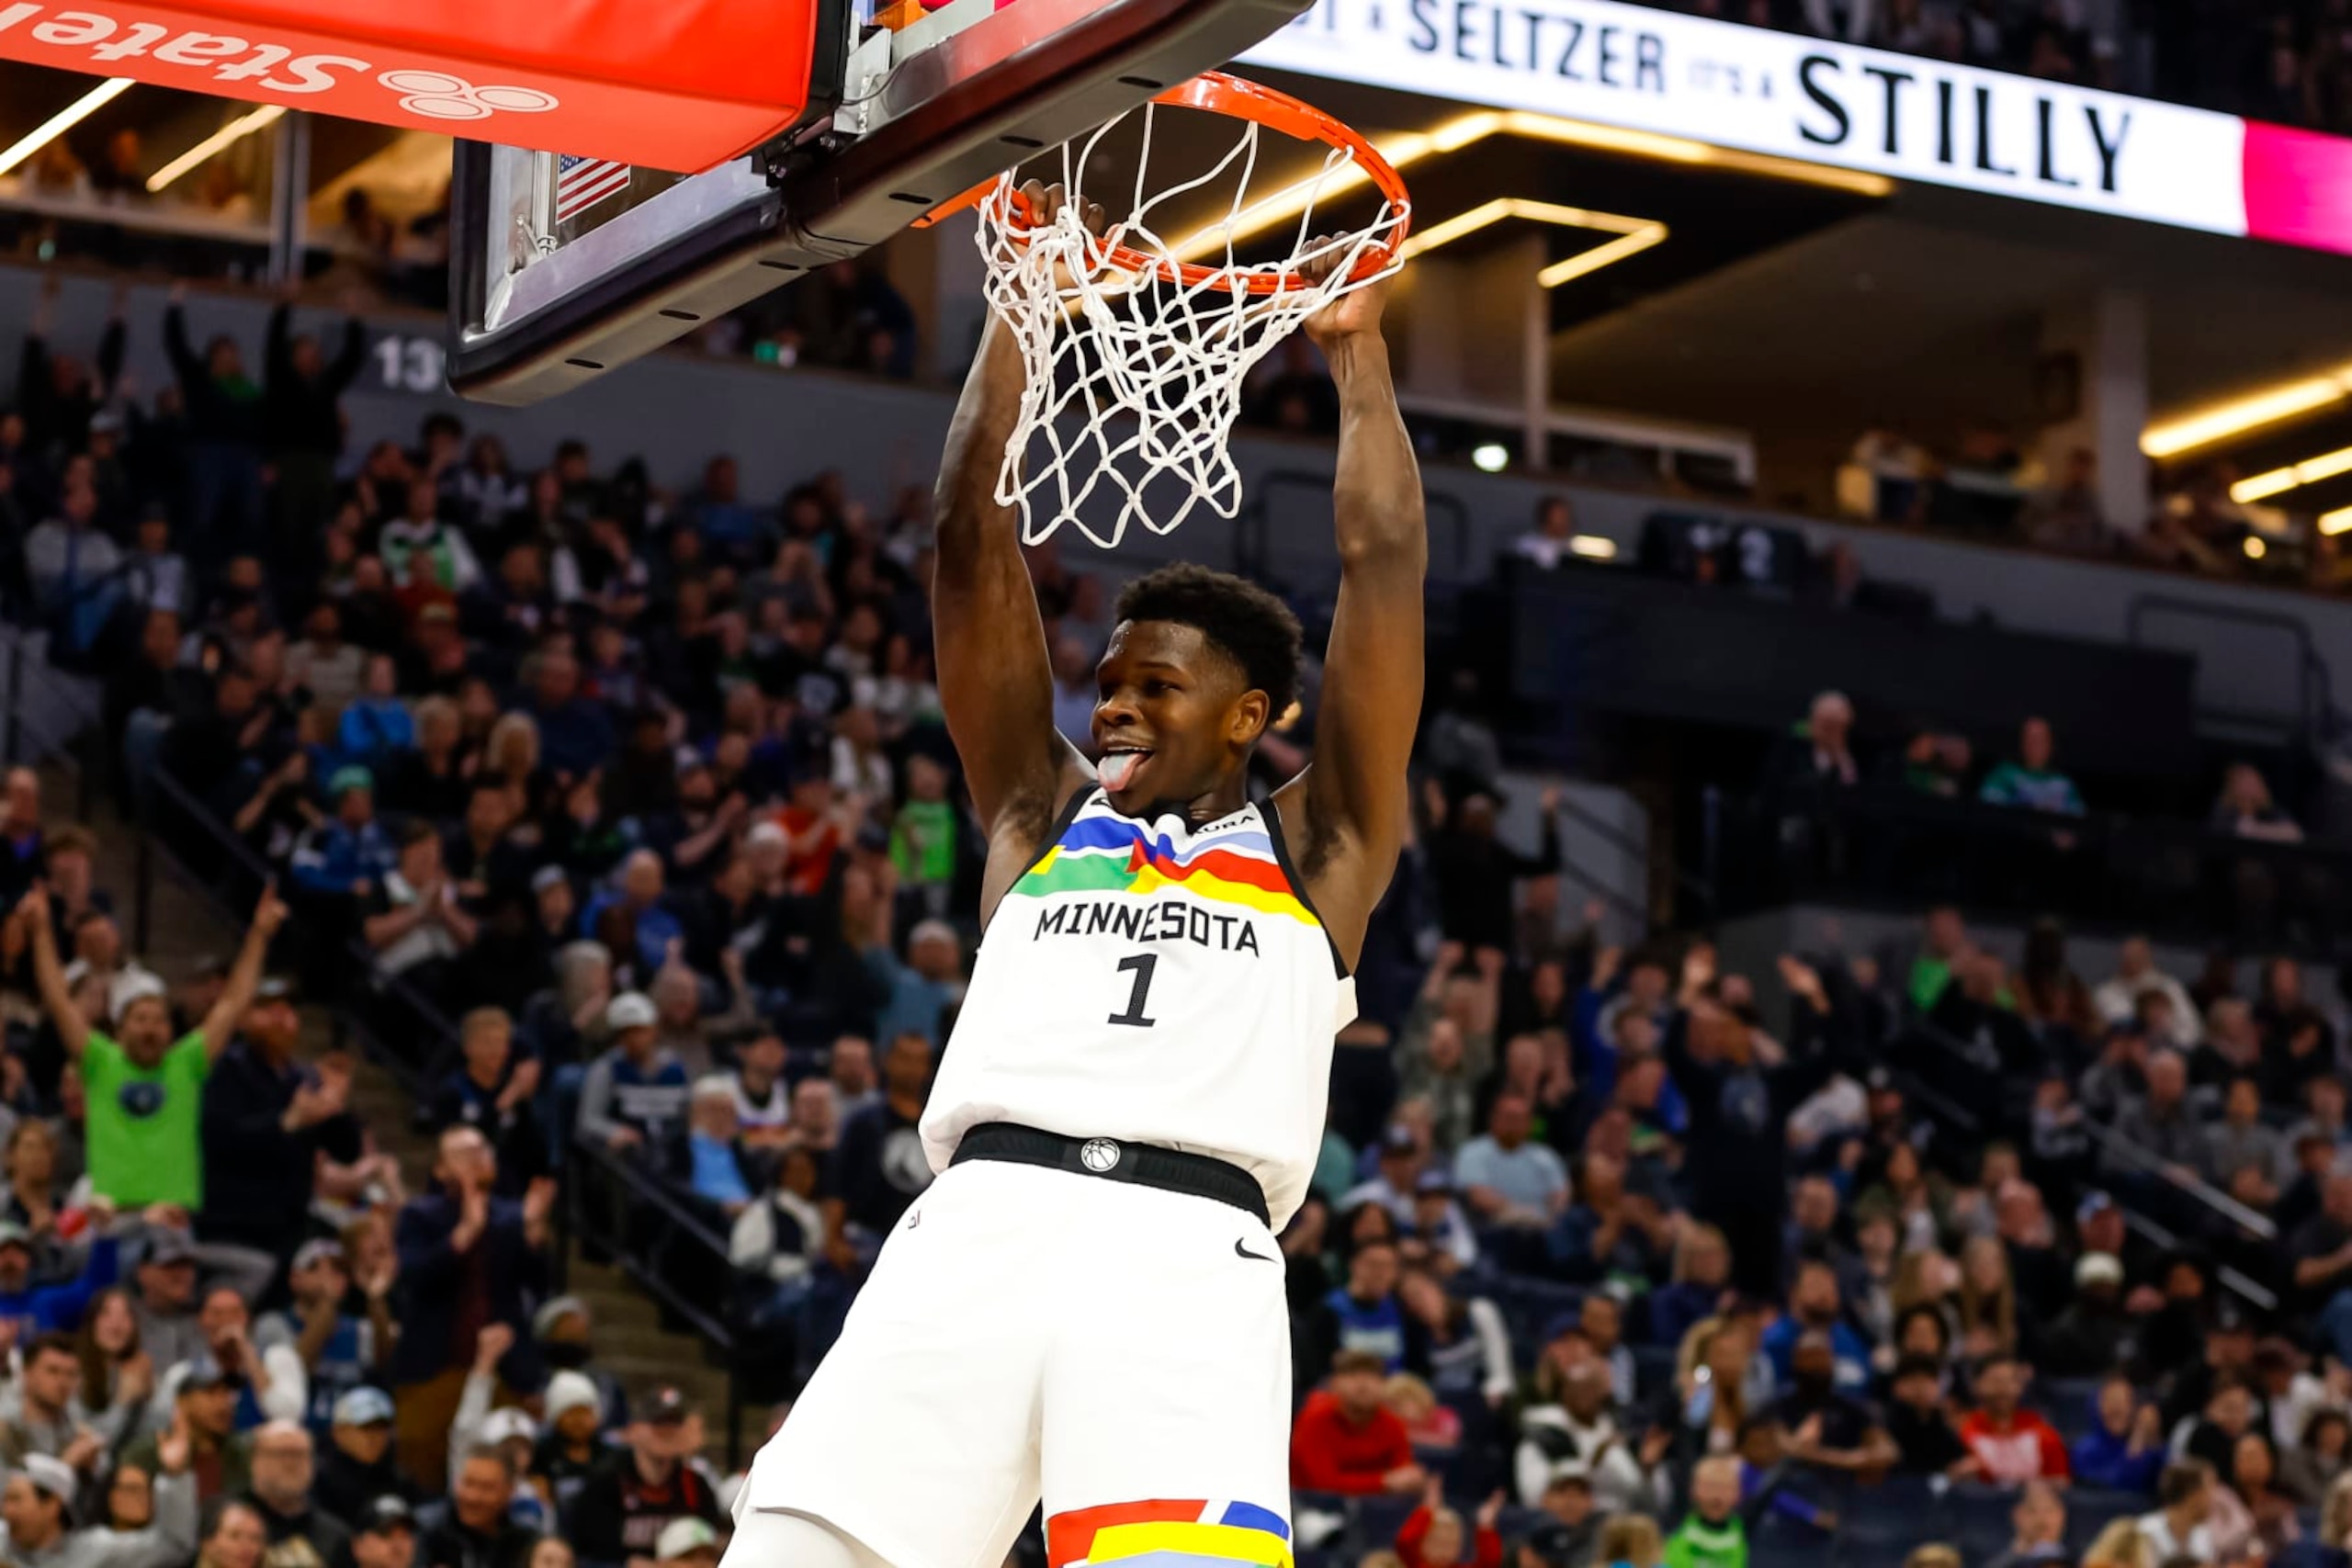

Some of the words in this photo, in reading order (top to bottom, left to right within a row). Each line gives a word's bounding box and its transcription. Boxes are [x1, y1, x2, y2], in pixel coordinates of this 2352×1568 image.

[1408, 0, 1666, 95] SELTZER
[1797, 54, 2132, 194] STILLY
[1033, 901, 1260, 959] MINNESOTA
[1107, 953, 1158, 1027] 1
